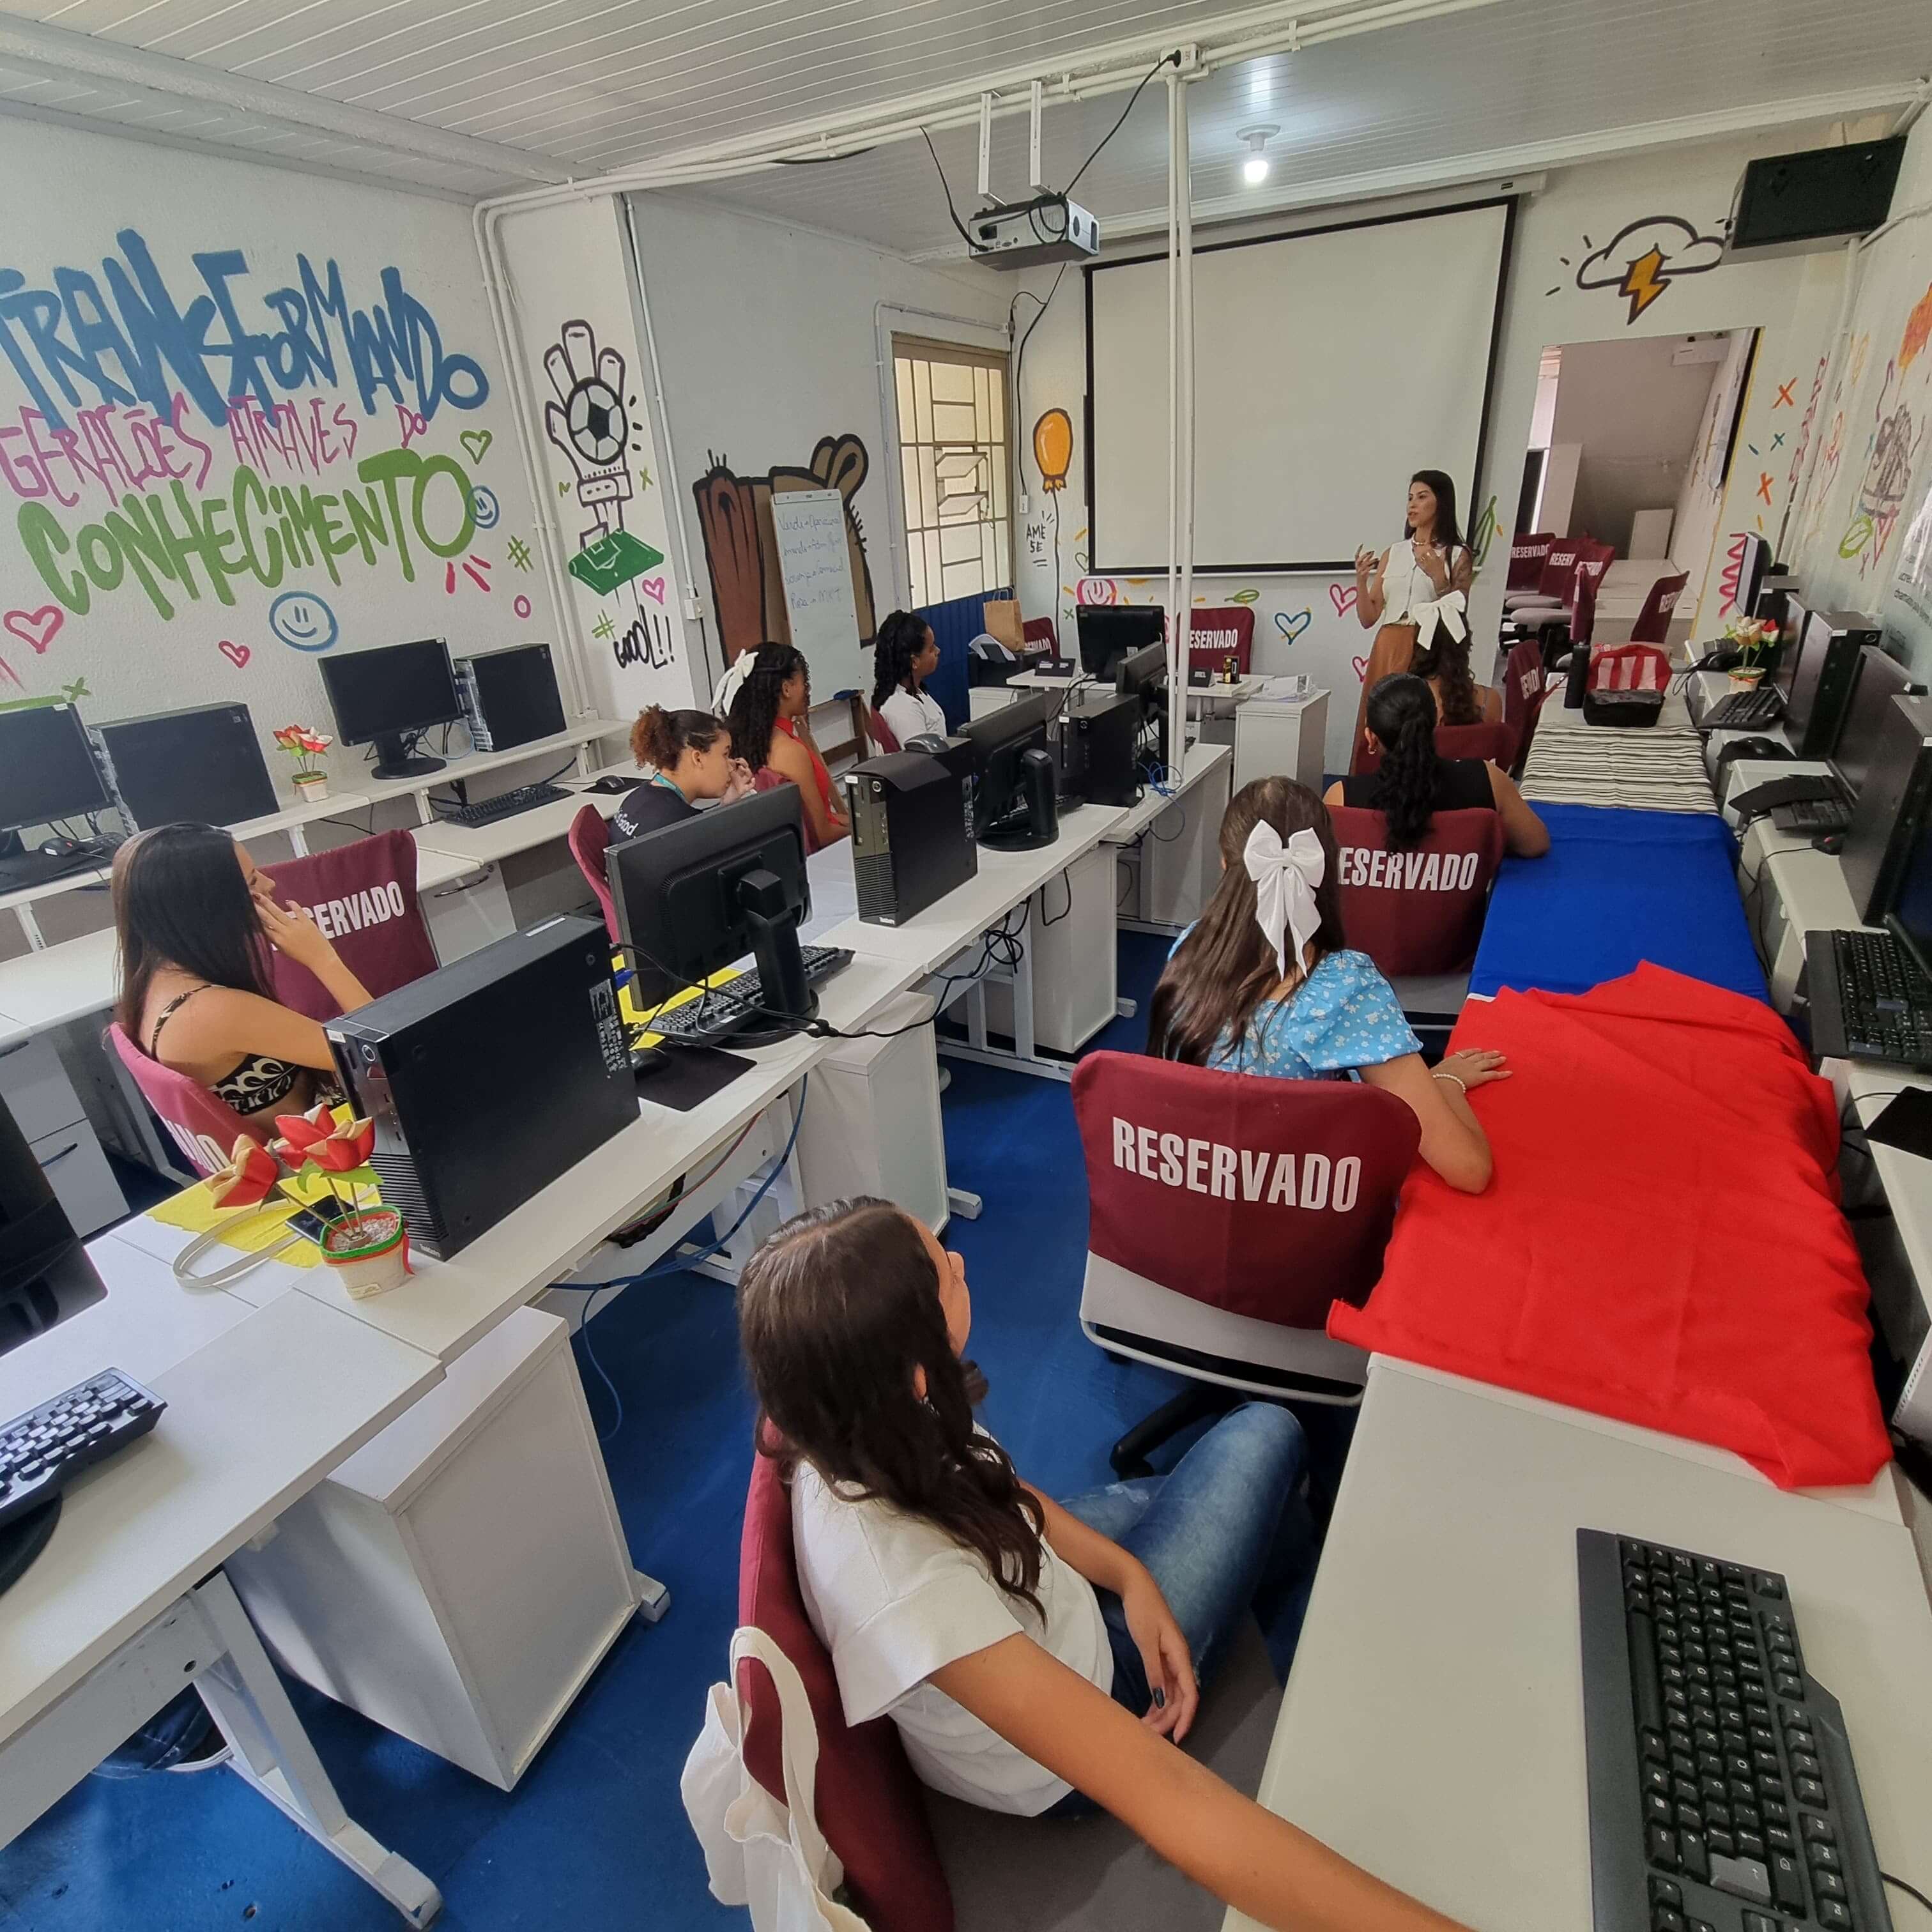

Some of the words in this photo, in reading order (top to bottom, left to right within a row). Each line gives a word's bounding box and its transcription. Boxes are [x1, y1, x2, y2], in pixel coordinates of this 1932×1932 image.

[394, 404, 427, 449] DO
[1027, 523, 1046, 541] AME
[1549, 553, 1575, 566] RESERV
[1190, 629, 1238, 648] ESERVADO
[1337, 847, 1479, 891] ESERVADO
[285, 880, 405, 941] ERVADO
[1112, 1116, 1361, 1213] RESERVADO
